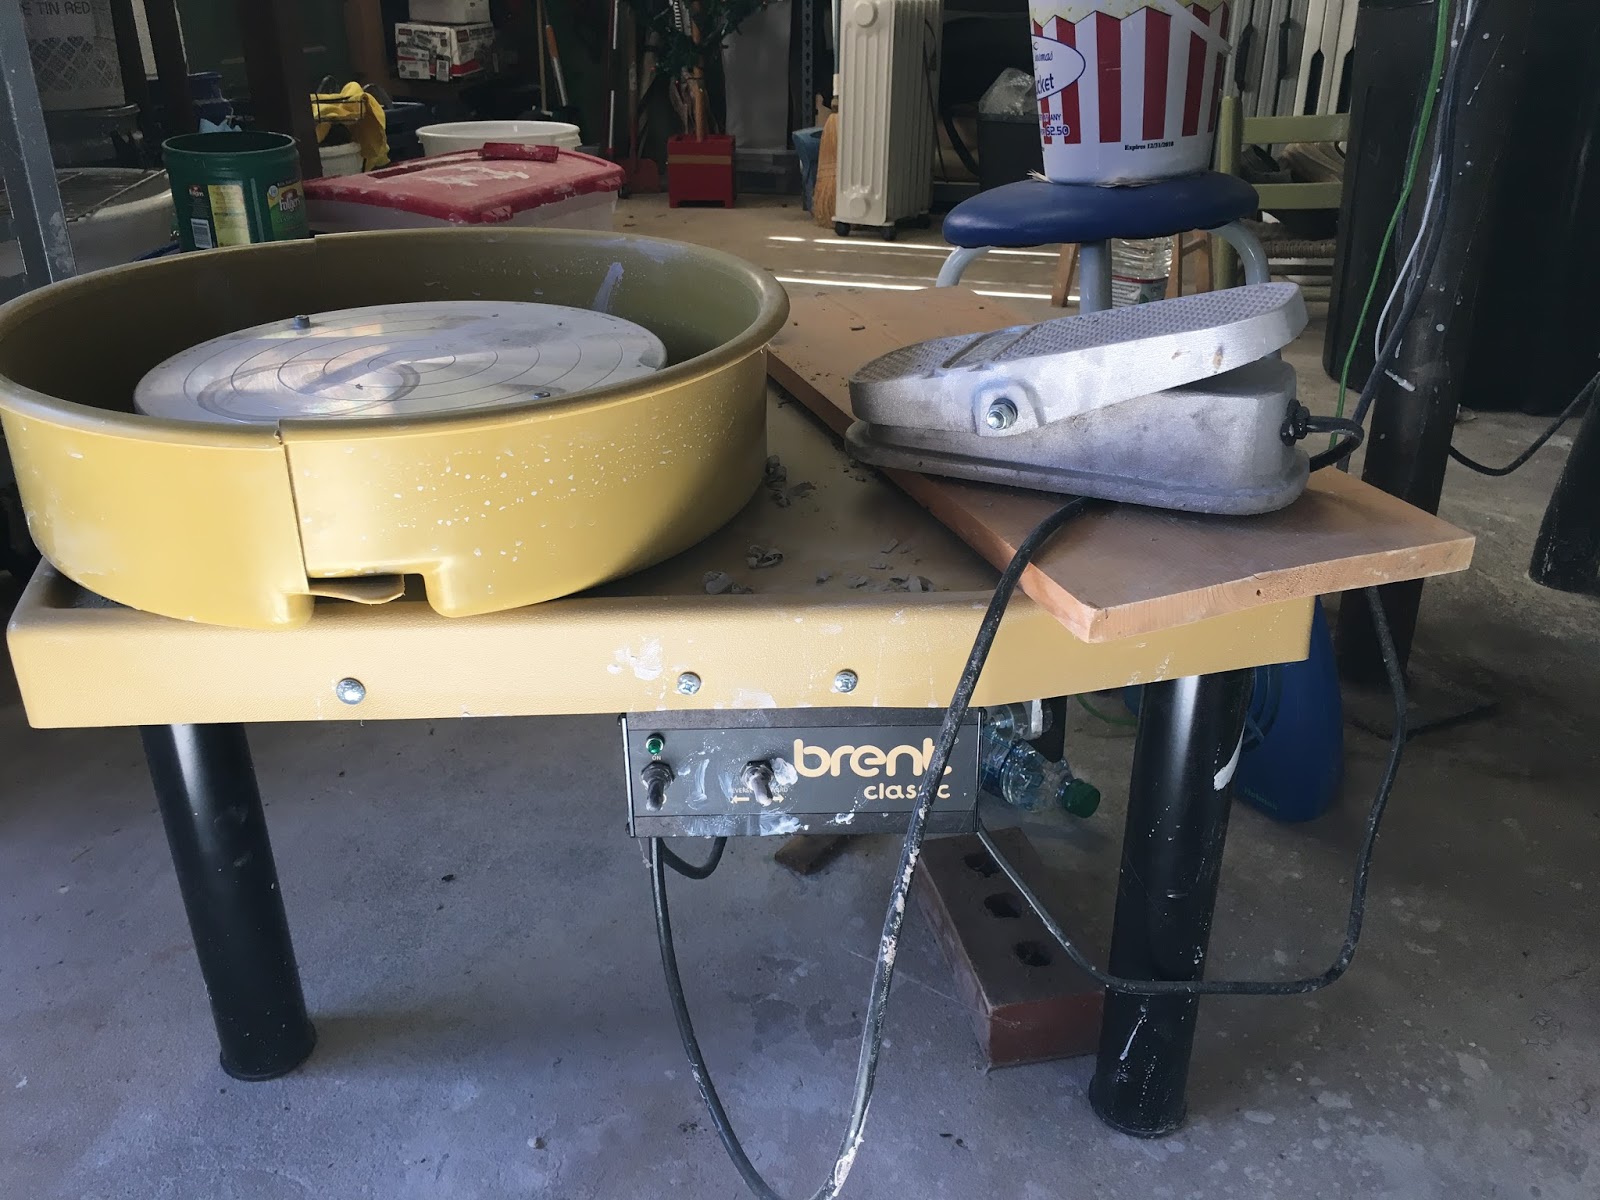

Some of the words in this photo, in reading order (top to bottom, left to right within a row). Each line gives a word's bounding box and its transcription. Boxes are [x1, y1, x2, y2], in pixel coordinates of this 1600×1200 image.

[36, 1, 60, 16] TIN
[1125, 144, 1146, 152] Expires
[793, 737, 952, 778] brent
[863, 783, 951, 800] clasc
